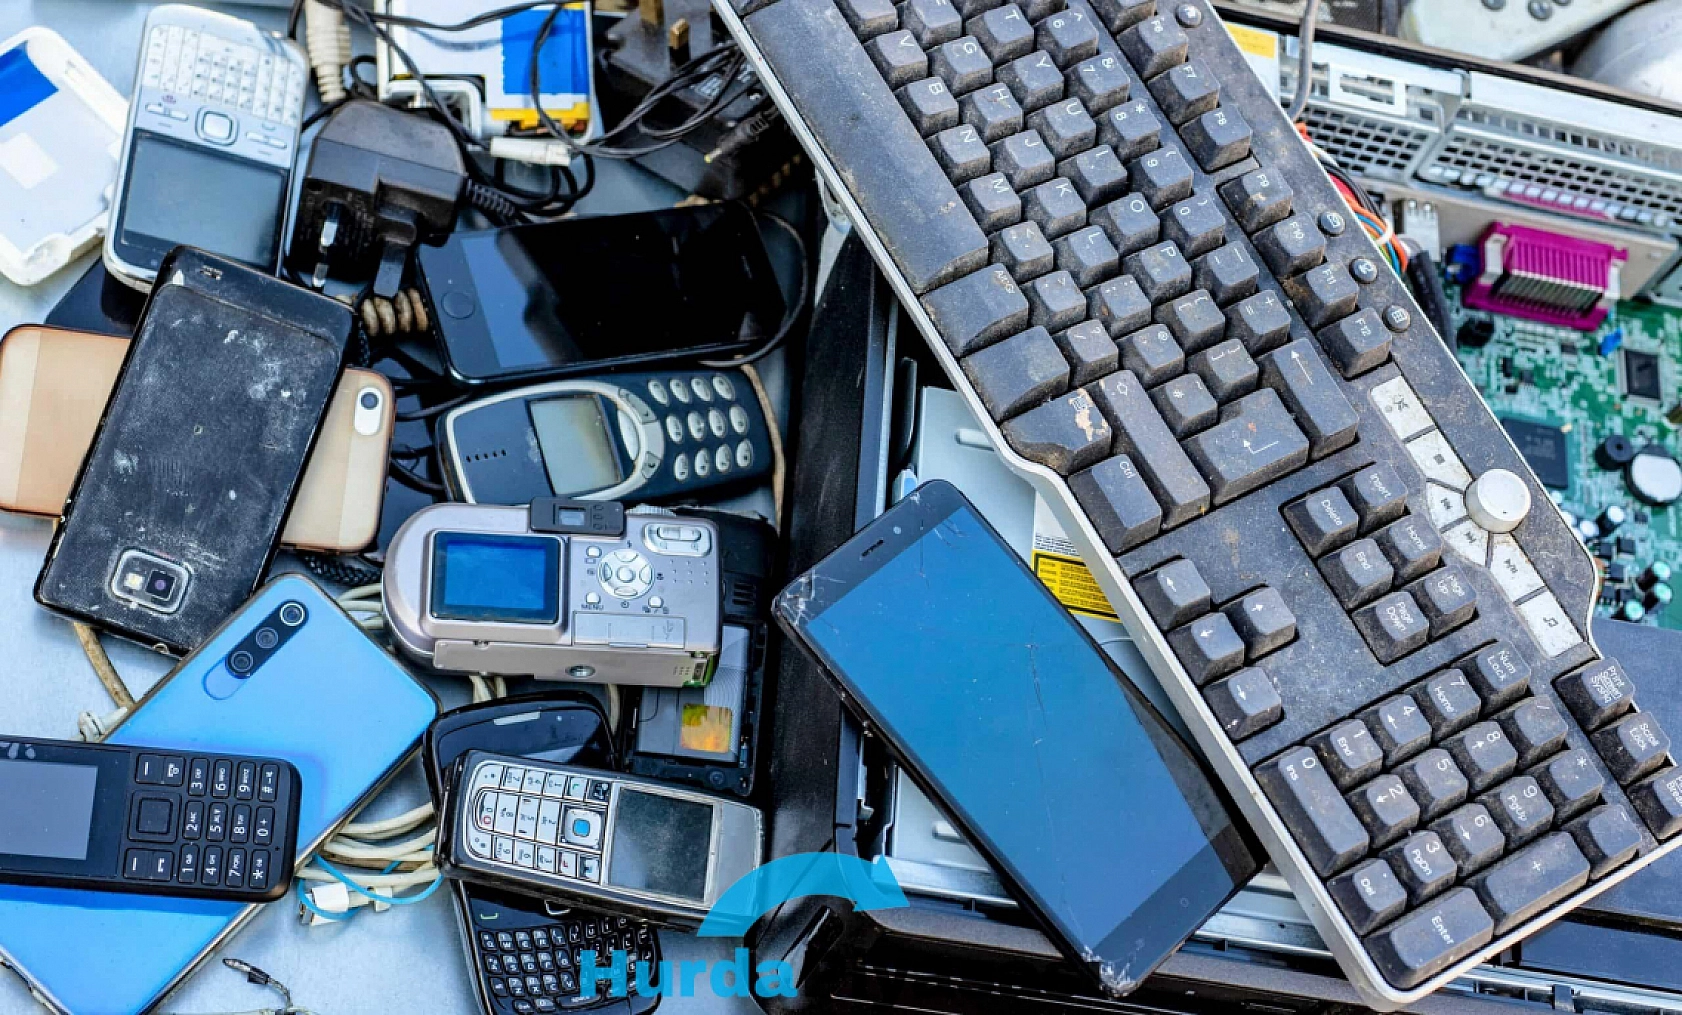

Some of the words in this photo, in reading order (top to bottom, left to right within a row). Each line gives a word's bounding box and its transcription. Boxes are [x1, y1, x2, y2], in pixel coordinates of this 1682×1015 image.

[1005, 10, 1019, 20] T
[1053, 19, 1064, 28] 6
[1151, 20, 1163, 33] F6
[900, 35, 914, 47] V
[963, 42, 976, 54] G
[1036, 57, 1051, 69] Y
[1083, 65, 1095, 73] 7
[1183, 65, 1197, 78] F7
[929, 82, 943, 95] B
[996, 88, 1009, 101] H
[1066, 105, 1081, 115] U
[1115, 112, 1127, 121] 8
[1214, 112, 1227, 126] F8
[960, 129, 976, 143] N
[1024, 138, 1039, 147] J
[1096, 149, 1108, 157] I
[1147, 159, 1158, 167] 9
[992, 178, 1009, 193] M
[1257, 174, 1269, 187] F9
[1056, 183, 1072, 197] K
[1130, 200, 1144, 212] O
[1179, 206, 1190, 215] 0
[1088, 232, 1101, 244] L
[1161, 246, 1176, 257] P
[1322, 268, 1337, 285] F11
[1369, 472, 1393, 499] Insert
[1321, 499, 1343, 526] Delete
[1356, 551, 1373, 570] End
[1450, 675, 1465, 686] 7
[1403, 705, 1417, 716] 4
[1354, 729, 1366, 738] 1
[1486, 731, 1500, 742] 8
[1301, 756, 1316, 769] 0
[1437, 758, 1451, 772] 5
[191, 782, 204, 790] 3
[215, 783, 227, 791] 6
[239, 784, 250, 793] 9
[1388, 784, 1404, 799] 2
[1523, 785, 1538, 799] 9
[1474, 814, 1489, 828] 6
[186, 823, 198, 832] 2
[210, 825, 221, 833] 5
[234, 826, 245, 834] 8
[257, 828, 268, 836] 0
[1425, 841, 1440, 853] 3
[205, 867, 217, 875] 4
[228, 869, 241, 877] 7
[1431, 915, 1455, 946] Enter
